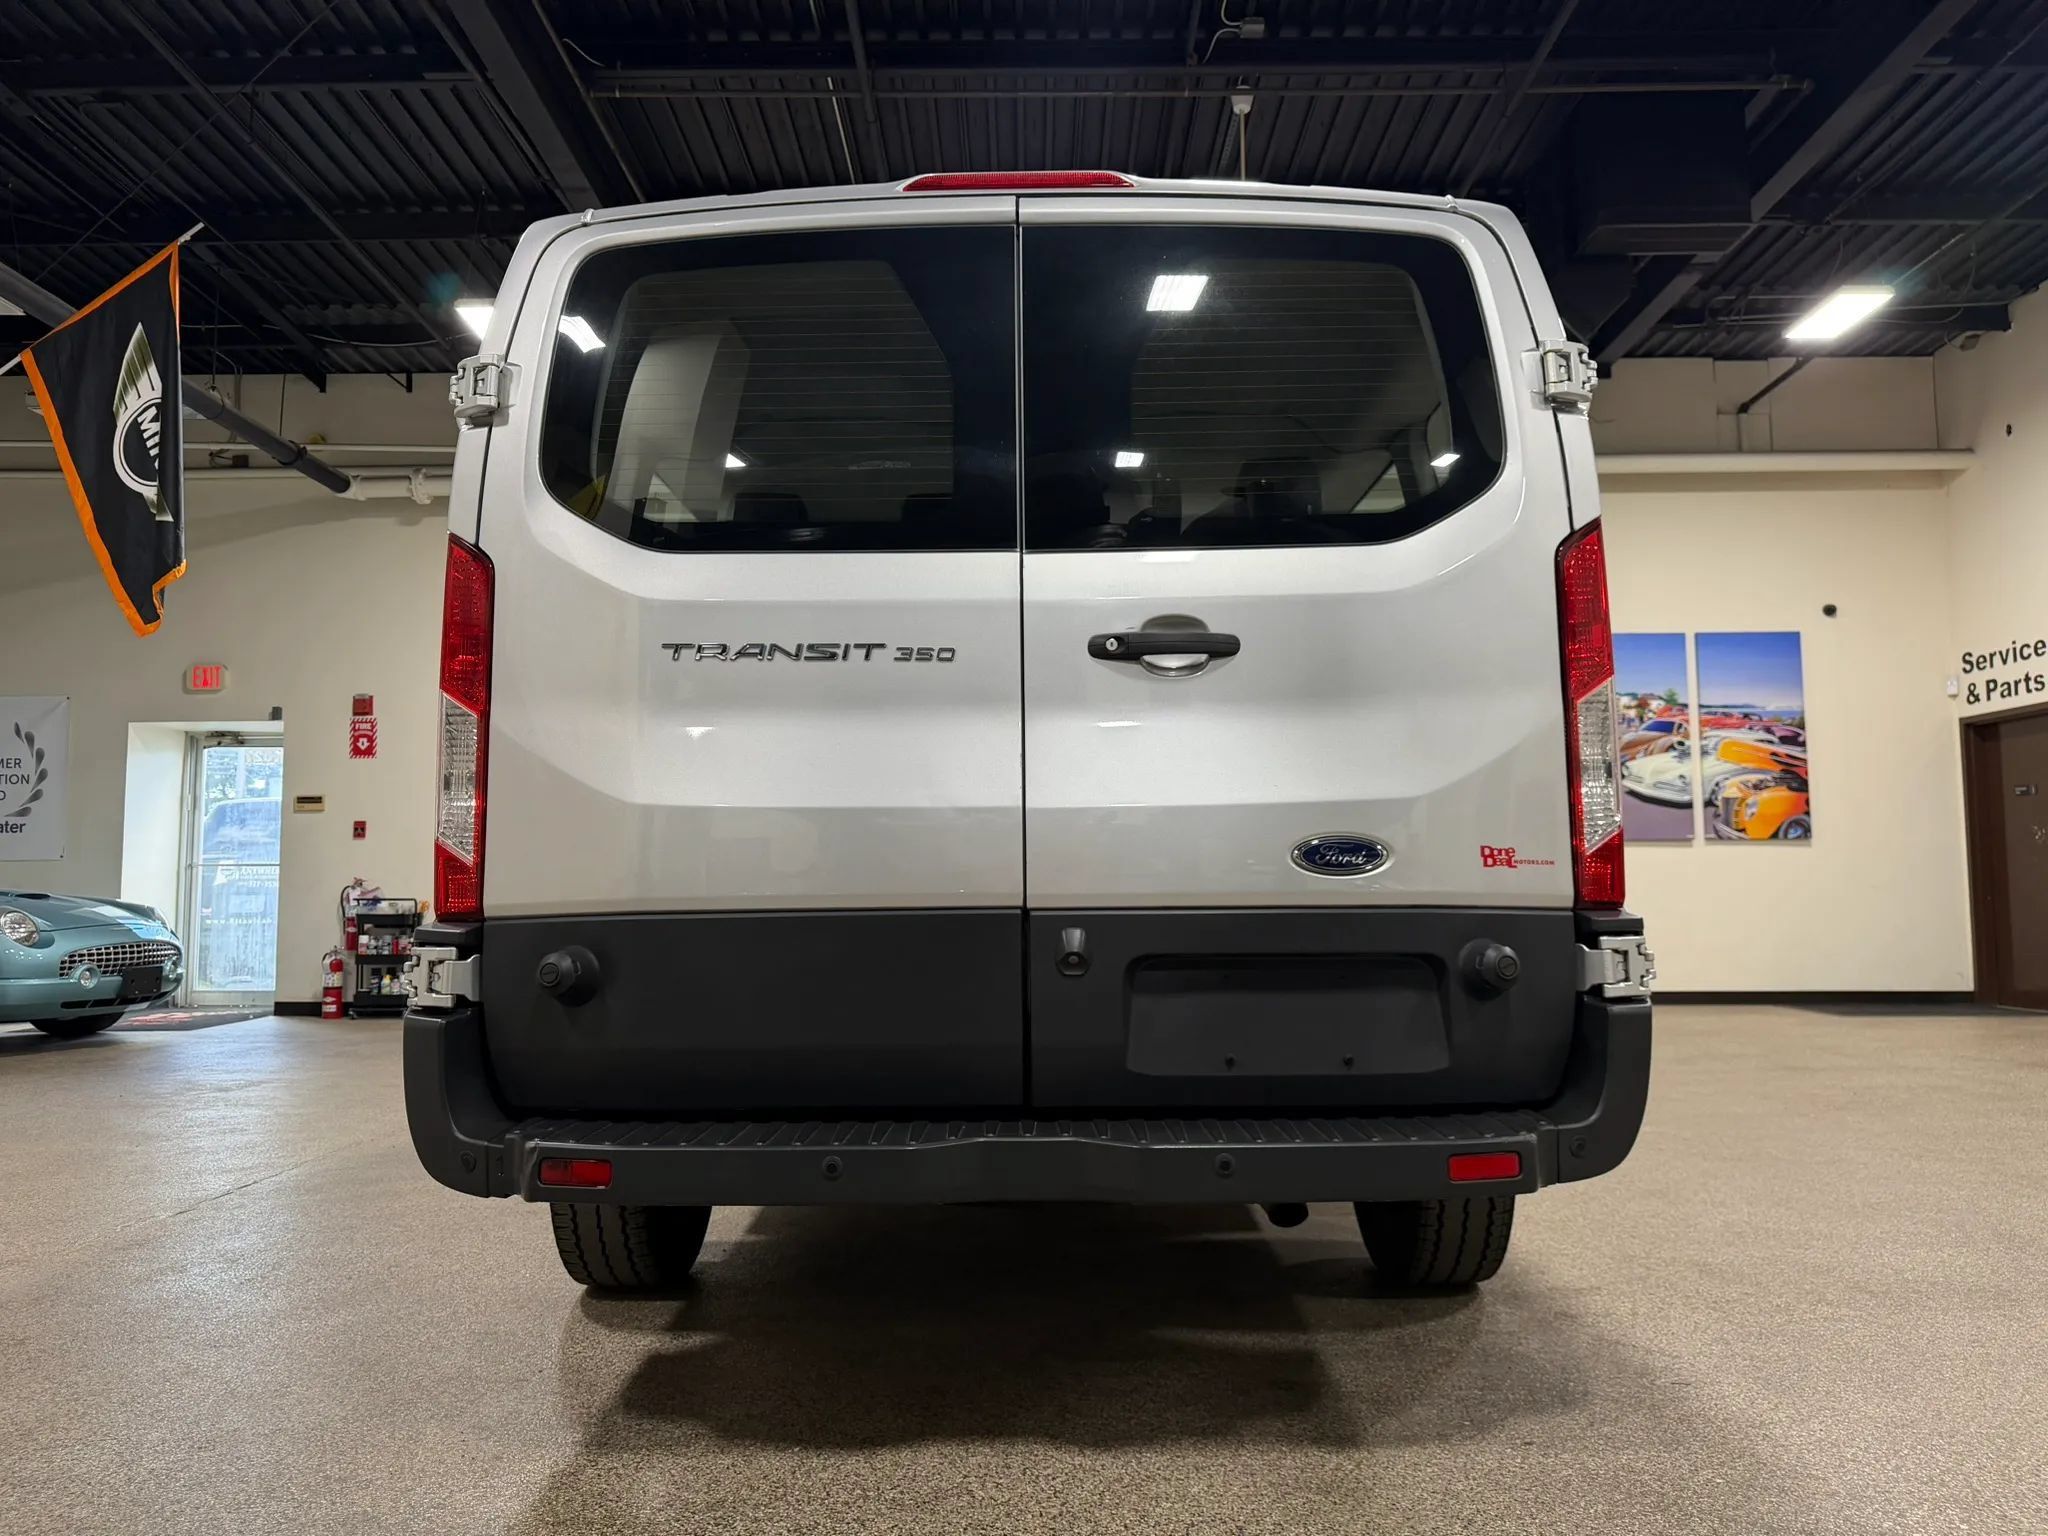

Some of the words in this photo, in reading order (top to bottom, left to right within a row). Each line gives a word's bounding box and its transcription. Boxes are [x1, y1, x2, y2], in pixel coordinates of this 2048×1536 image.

[661, 643, 887, 661] TRANSIT
[893, 646, 956, 662] 350
[1961, 639, 2047, 674] Service
[192, 665, 222, 689] EXIT
[1966, 683, 1981, 705] &
[1986, 671, 2045, 702] Parts
[1314, 843, 1367, 865] Ford
[1480, 845, 1516, 858] Done
